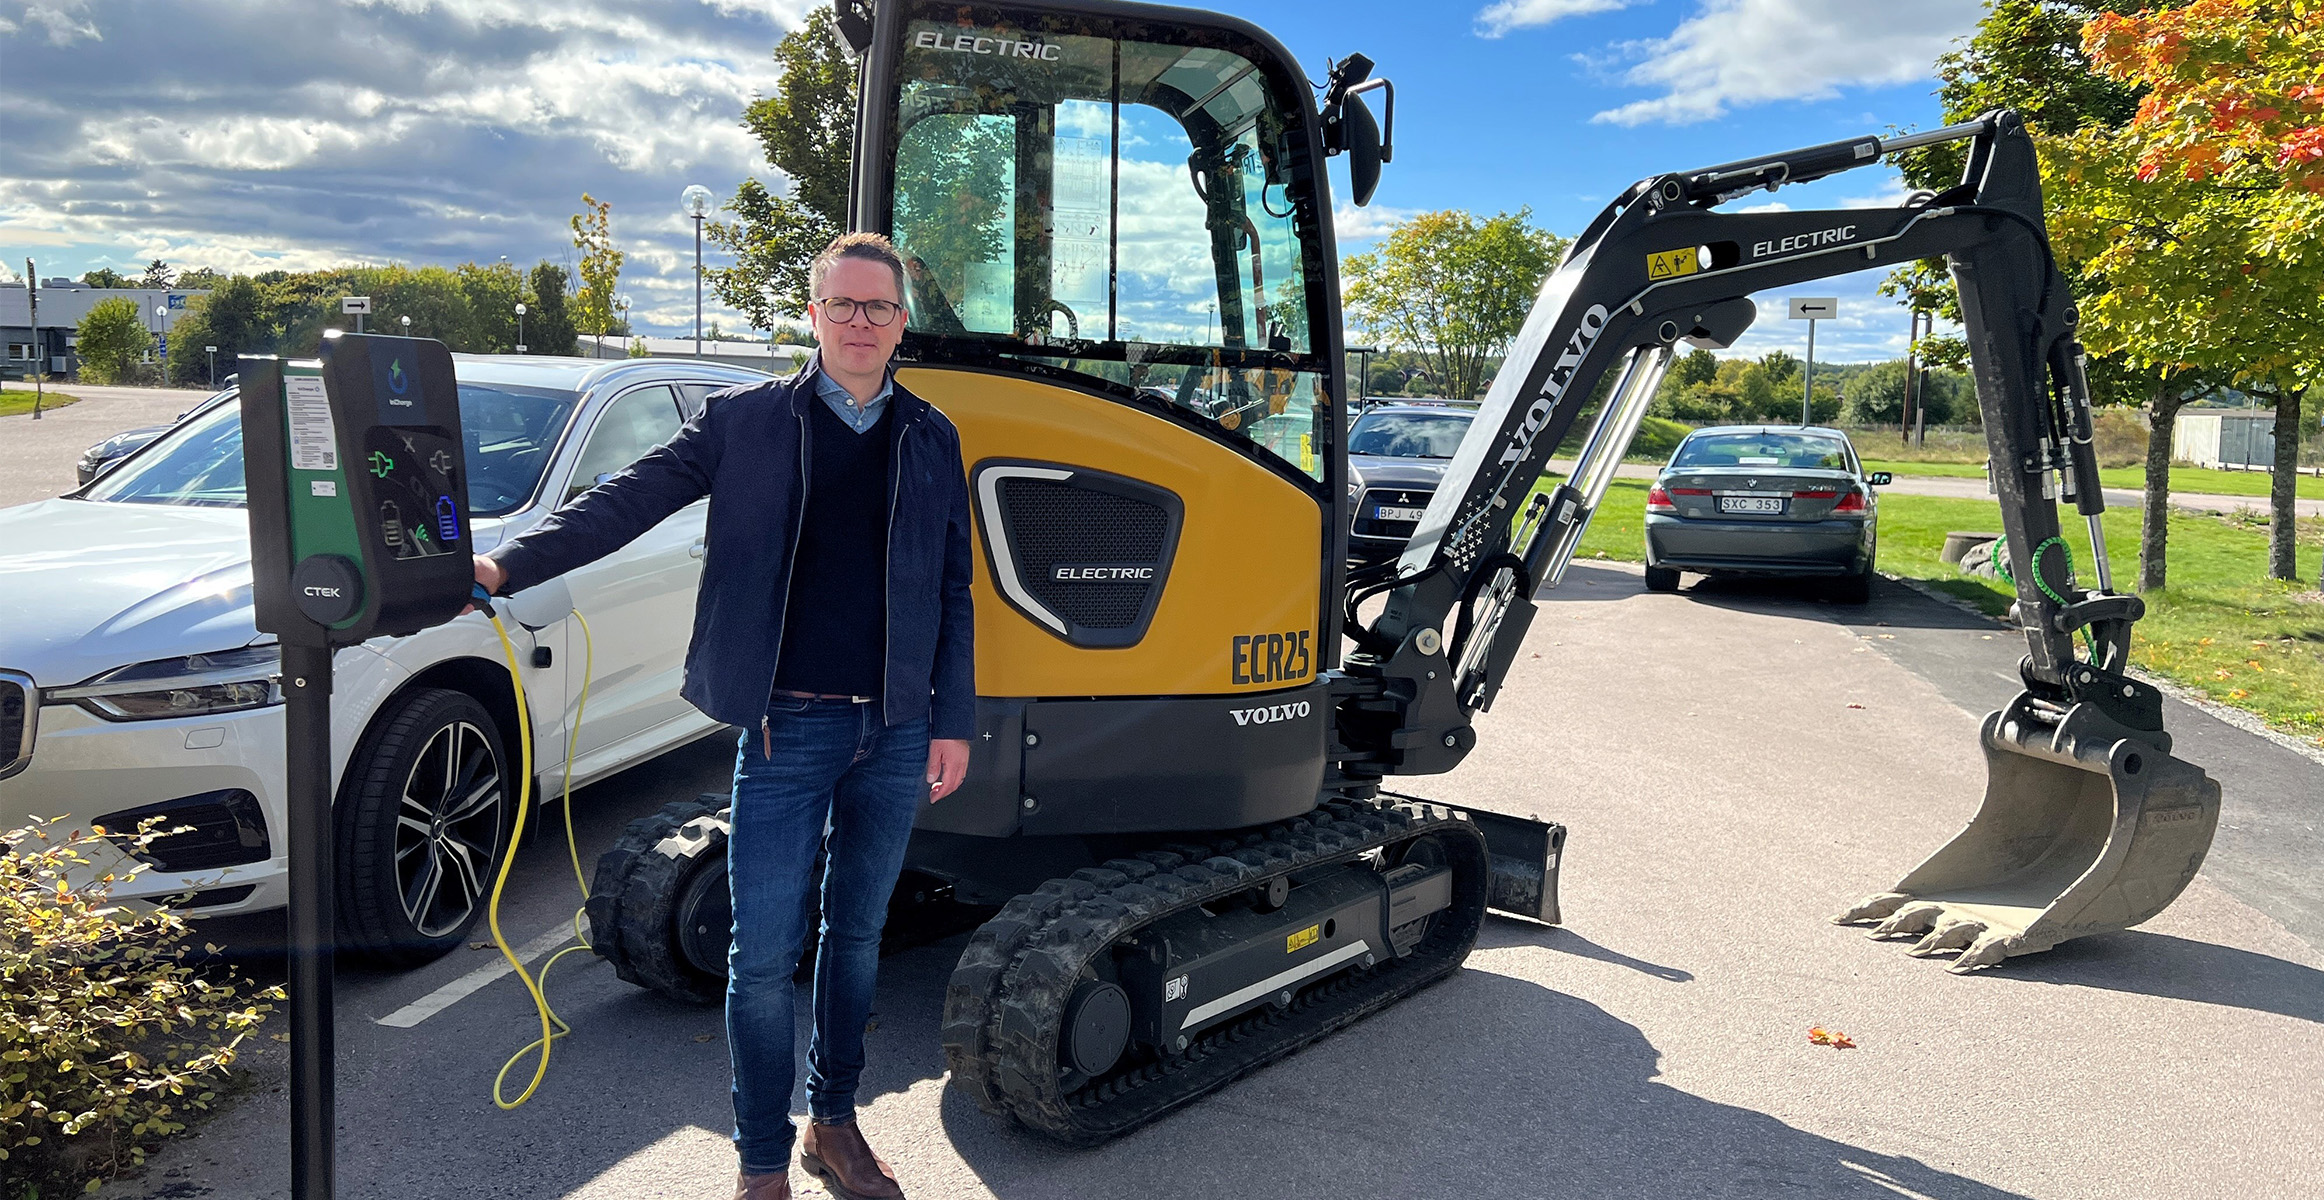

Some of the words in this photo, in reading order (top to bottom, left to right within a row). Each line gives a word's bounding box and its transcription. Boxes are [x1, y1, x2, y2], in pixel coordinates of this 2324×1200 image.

[914, 31, 1062, 61] ELECTRIC
[1752, 224, 1857, 258] ELECTRIC
[1498, 303, 1609, 466] VOLVO
[1380, 508, 1402, 519] BPJ
[1409, 510, 1425, 520] 49
[1723, 498, 1748, 510] SXC
[1755, 500, 1780, 511] 353
[1056, 567, 1154, 579] ELECTRIC
[304, 586, 341, 598] CTEK
[1232, 630, 1309, 685] ECR25
[1229, 700, 1310, 726] VOLVO
